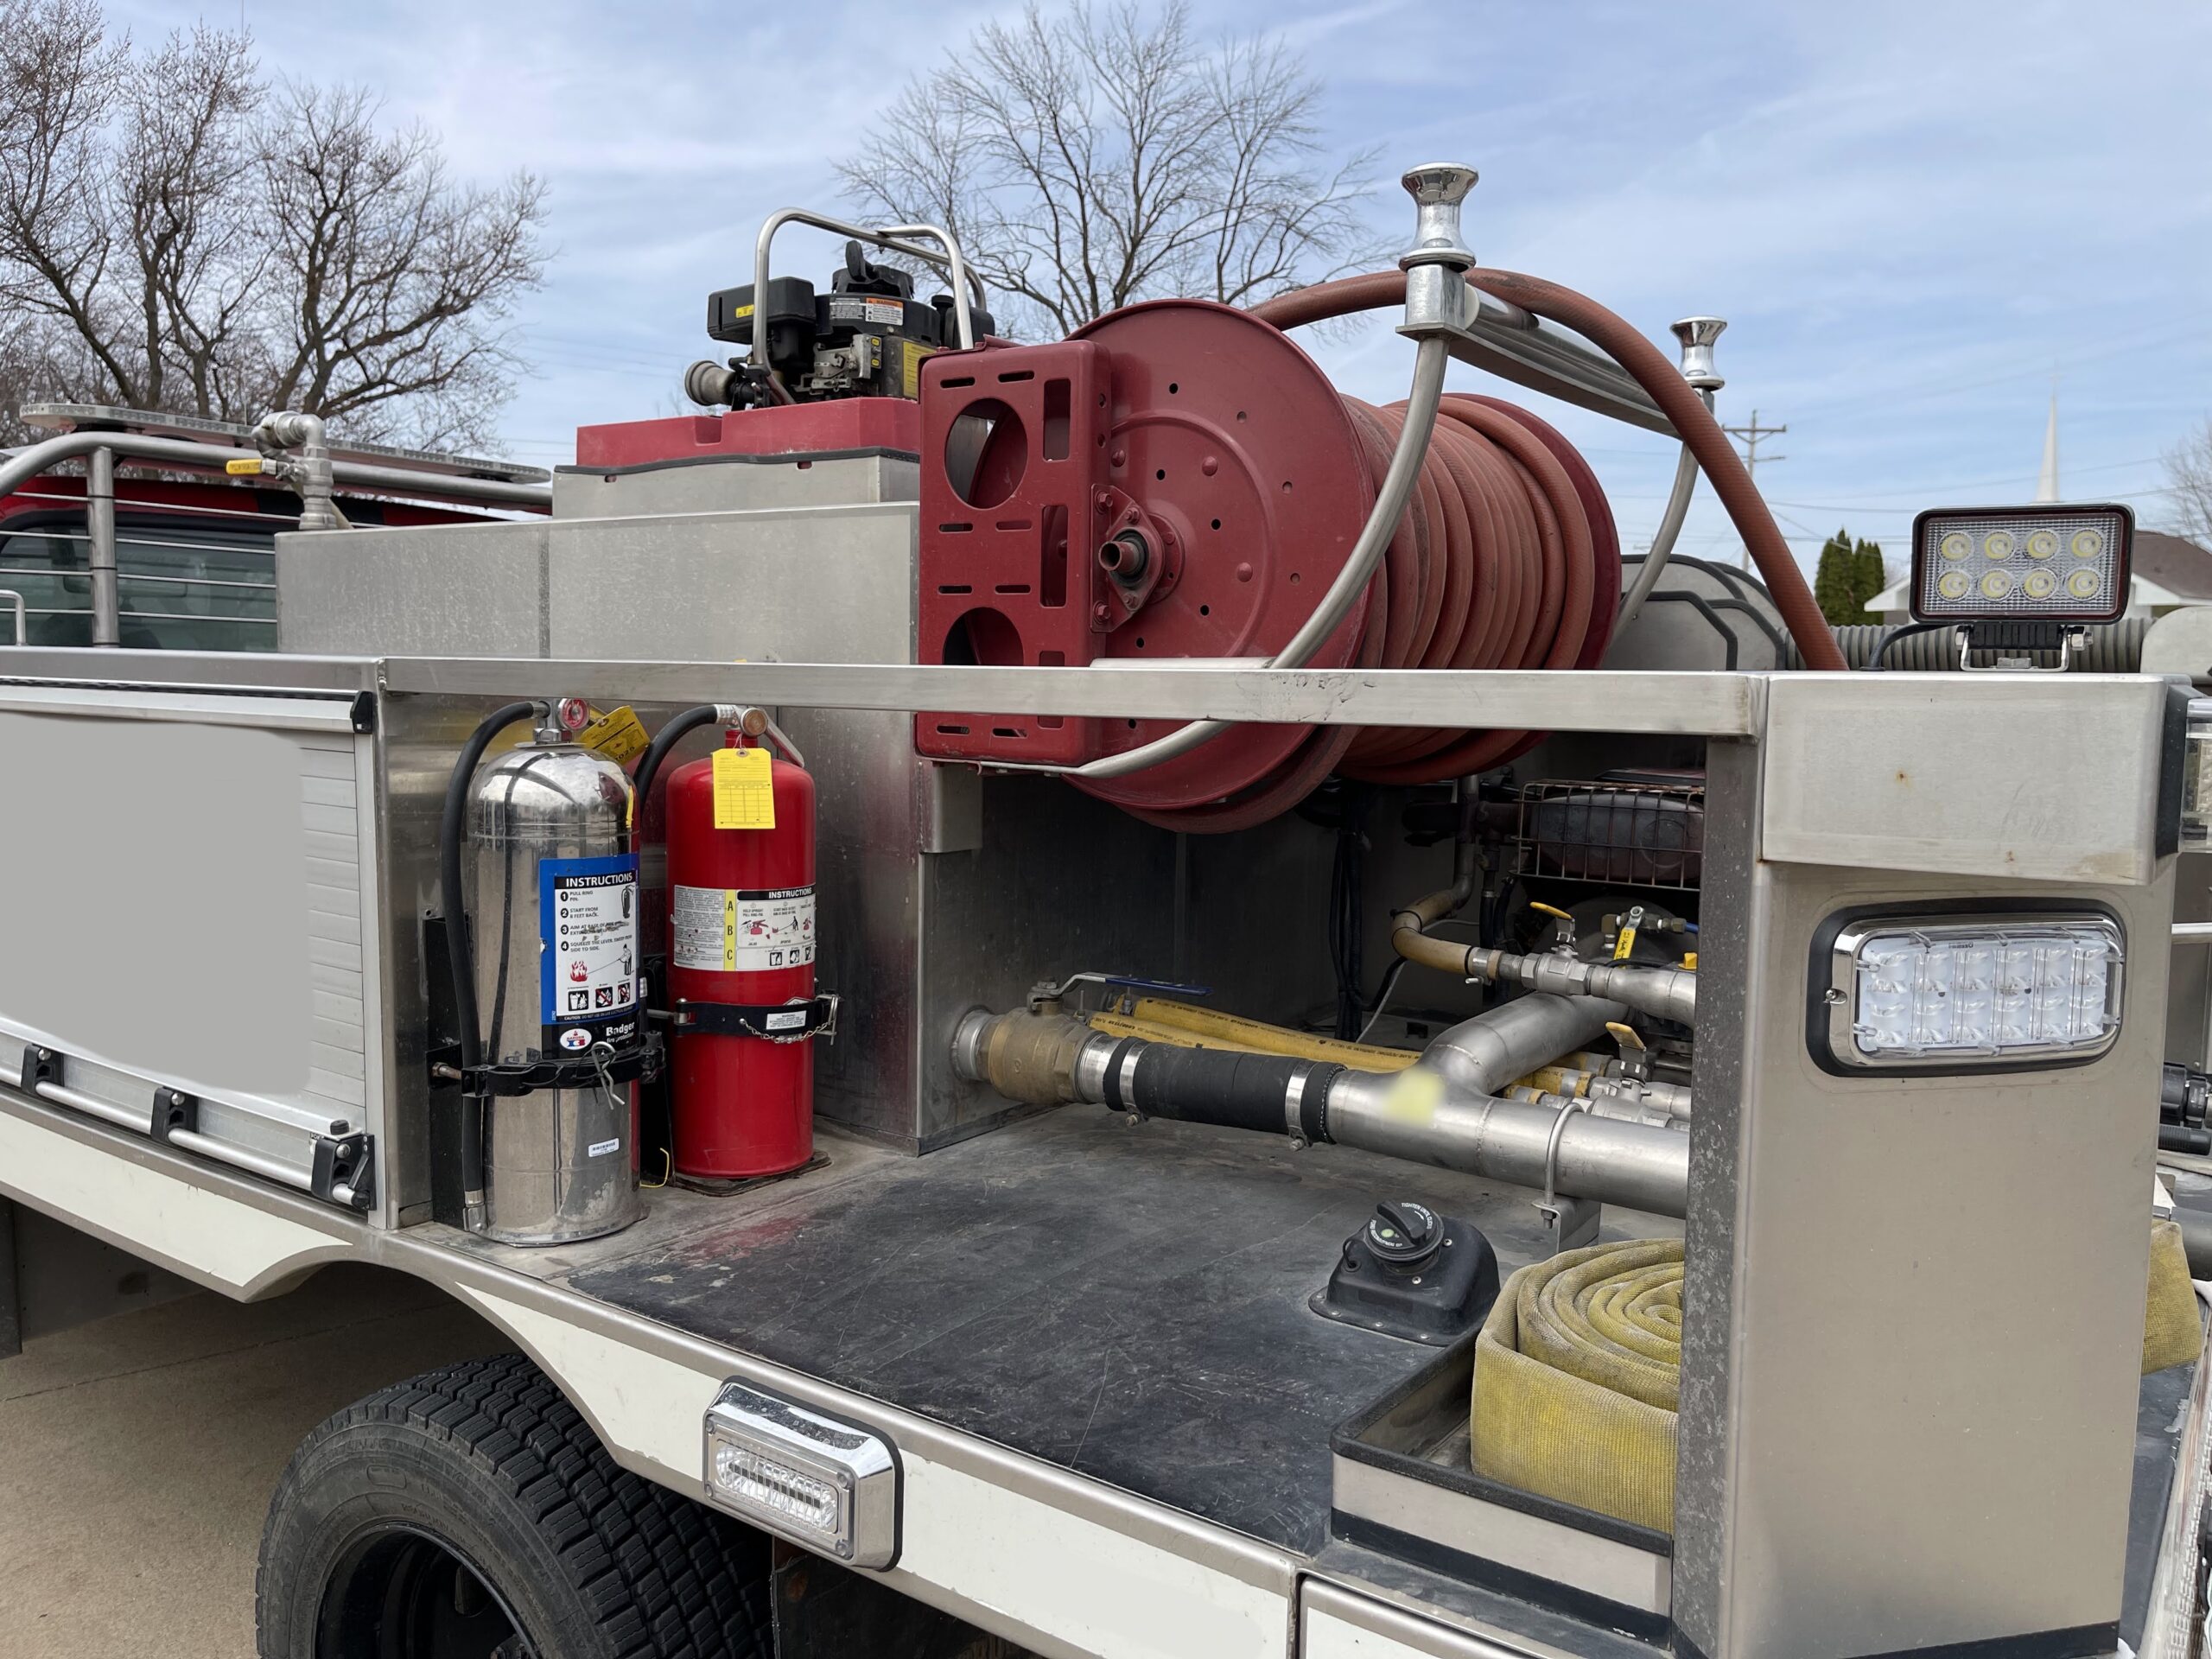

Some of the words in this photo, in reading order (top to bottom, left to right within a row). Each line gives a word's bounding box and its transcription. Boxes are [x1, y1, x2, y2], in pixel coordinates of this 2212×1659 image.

[566, 873, 632, 887] INSTRUCTIONS
[768, 887, 812, 899] INSTRUCTIONS
[728, 900, 734, 912] A
[728, 925, 734, 936] B
[727, 949, 733, 961] C
[606, 1021, 635, 1037] Badger
[1401, 1202, 1421, 1211] TIGHTEN
